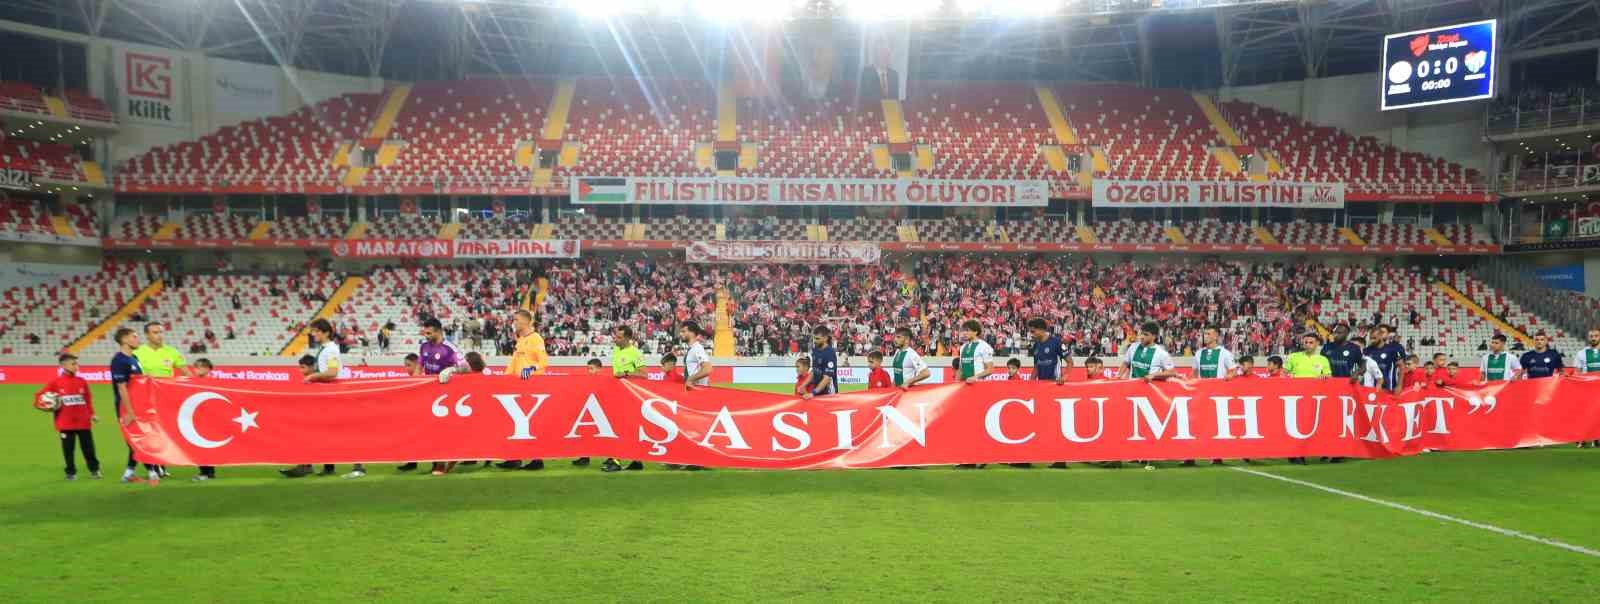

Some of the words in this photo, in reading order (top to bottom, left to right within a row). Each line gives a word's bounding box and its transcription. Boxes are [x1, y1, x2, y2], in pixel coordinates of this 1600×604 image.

[1421, 79, 1452, 91] 00:00
[128, 99, 172, 121] Kilit
[635, 179, 769, 201] FİLİSTİNDE
[780, 179, 896, 202] İNSANLIK
[906, 180, 1016, 203] ÖLÜYOR!
[1106, 182, 1189, 203] ÖZGÜR
[1199, 182, 1303, 203] FİLİSTİN!
[356, 241, 449, 256] MARATON
